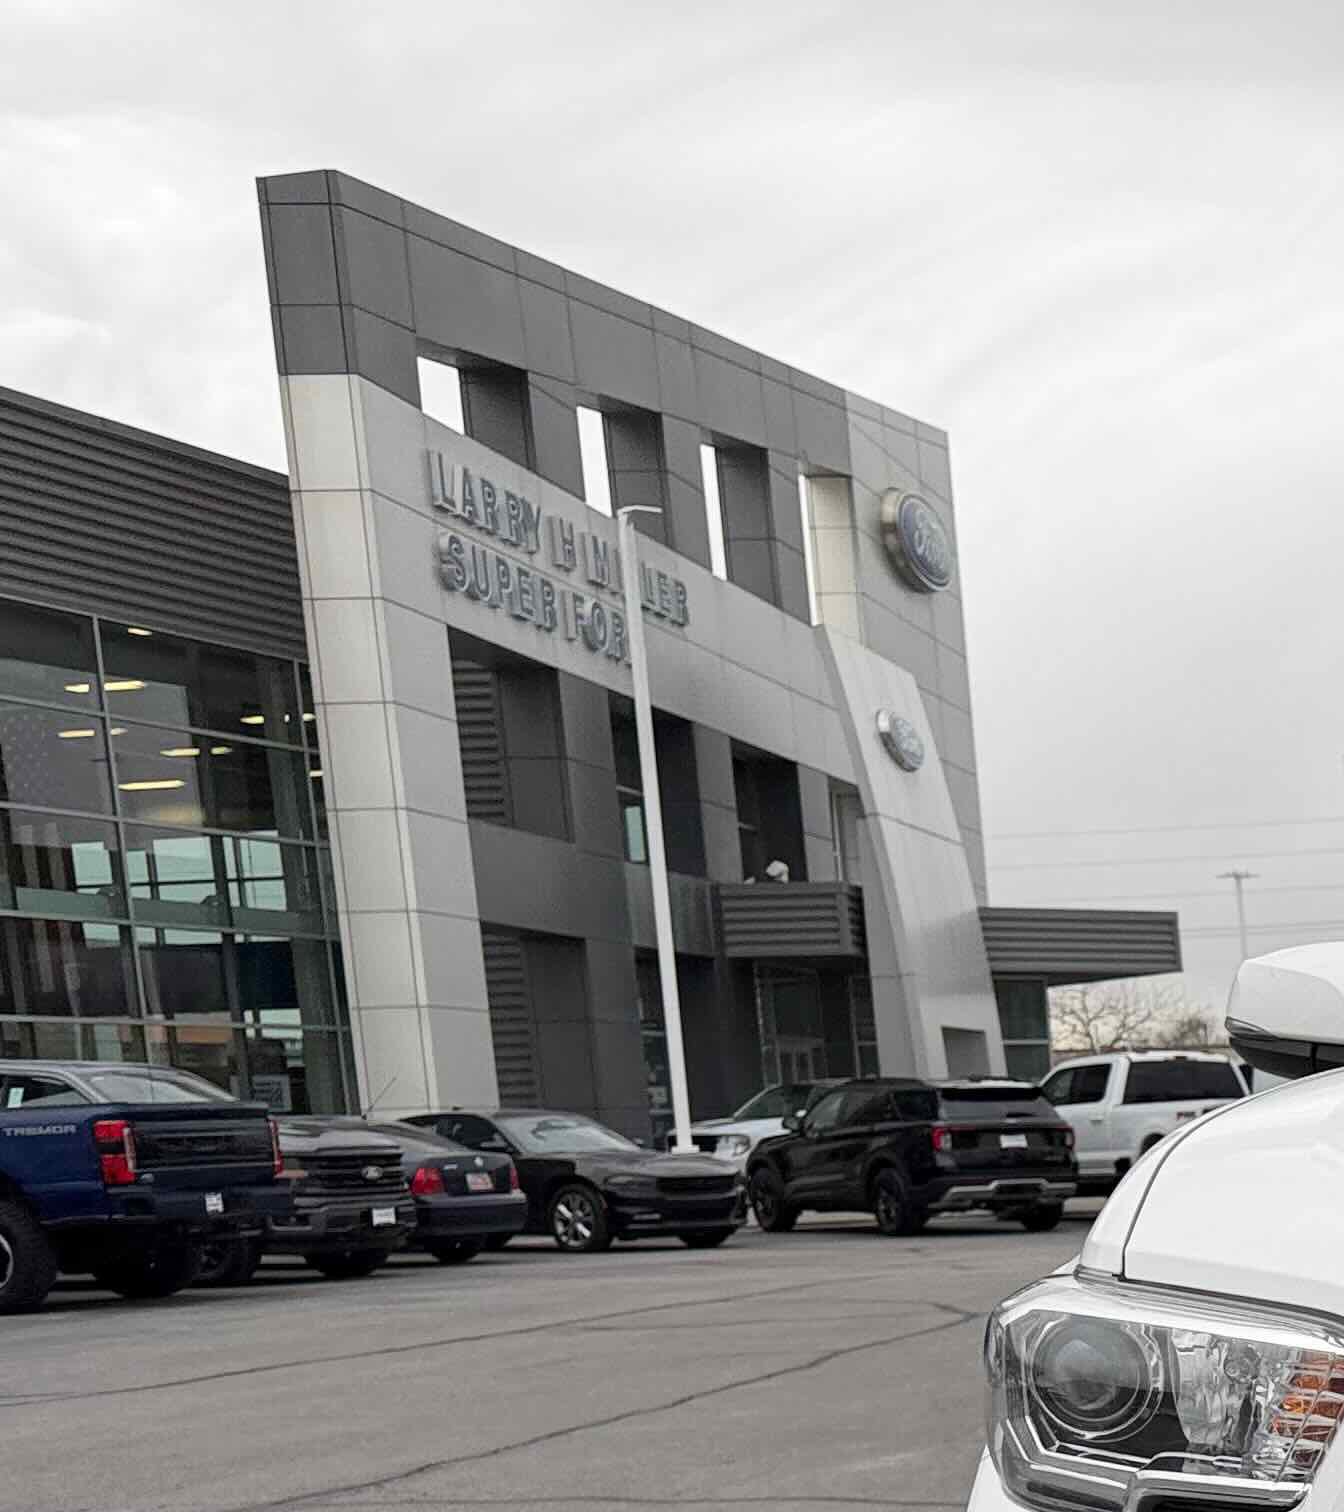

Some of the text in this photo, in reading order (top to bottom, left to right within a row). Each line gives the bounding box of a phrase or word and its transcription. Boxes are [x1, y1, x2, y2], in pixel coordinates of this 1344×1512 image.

[427, 450, 542, 556] LARRY
[547, 514, 577, 572] H
[437, 531, 634, 669] SUPER FOR
[2, 1124, 77, 1137] TREMOR
